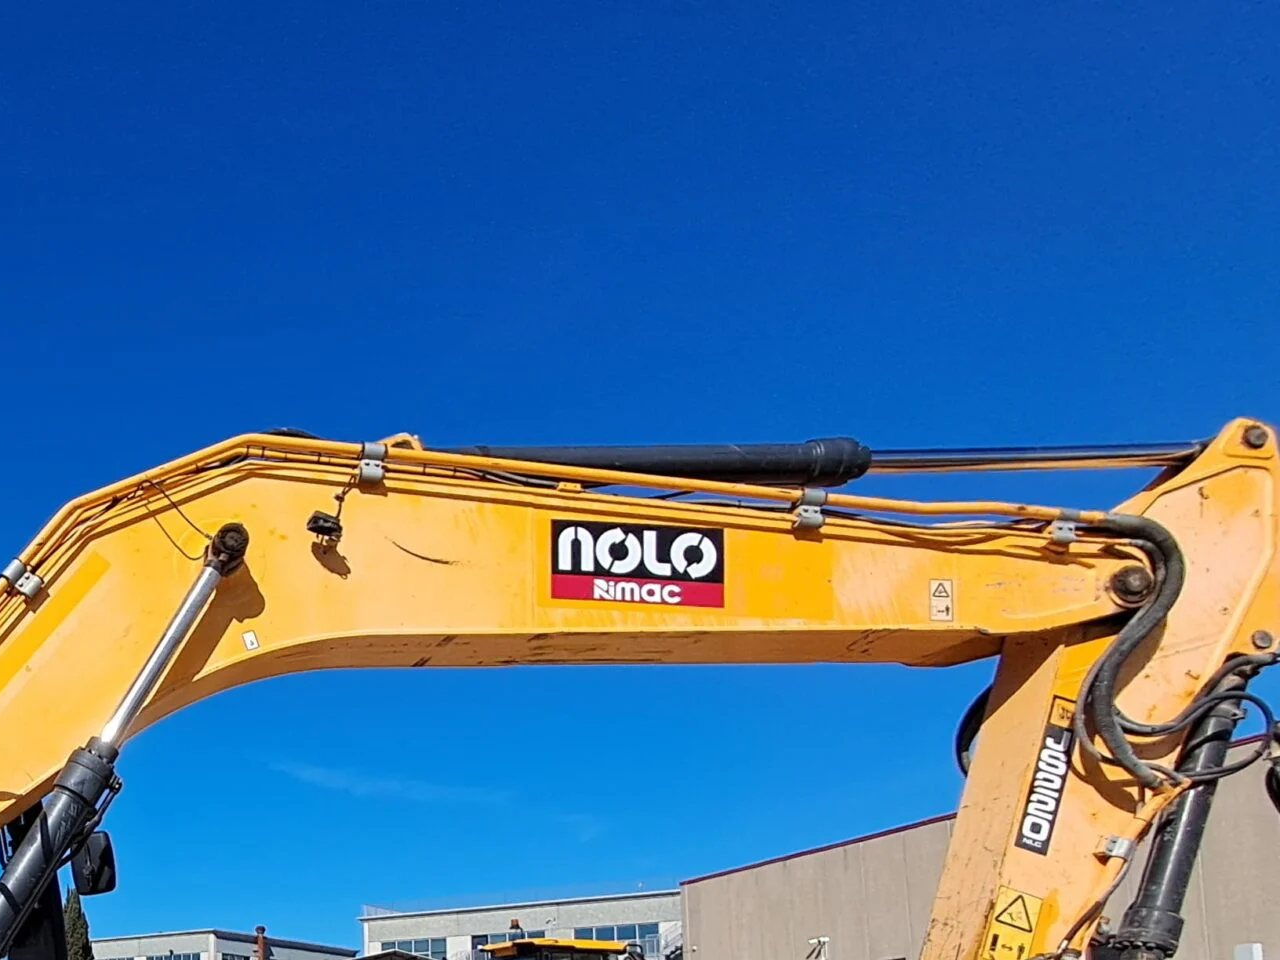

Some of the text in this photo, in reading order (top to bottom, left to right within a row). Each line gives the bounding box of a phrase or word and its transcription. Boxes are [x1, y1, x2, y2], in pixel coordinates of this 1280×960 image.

[558, 526, 717, 580] NOLO
[593, 578, 682, 604] Rimac
[1023, 837, 1042, 848] NLC
